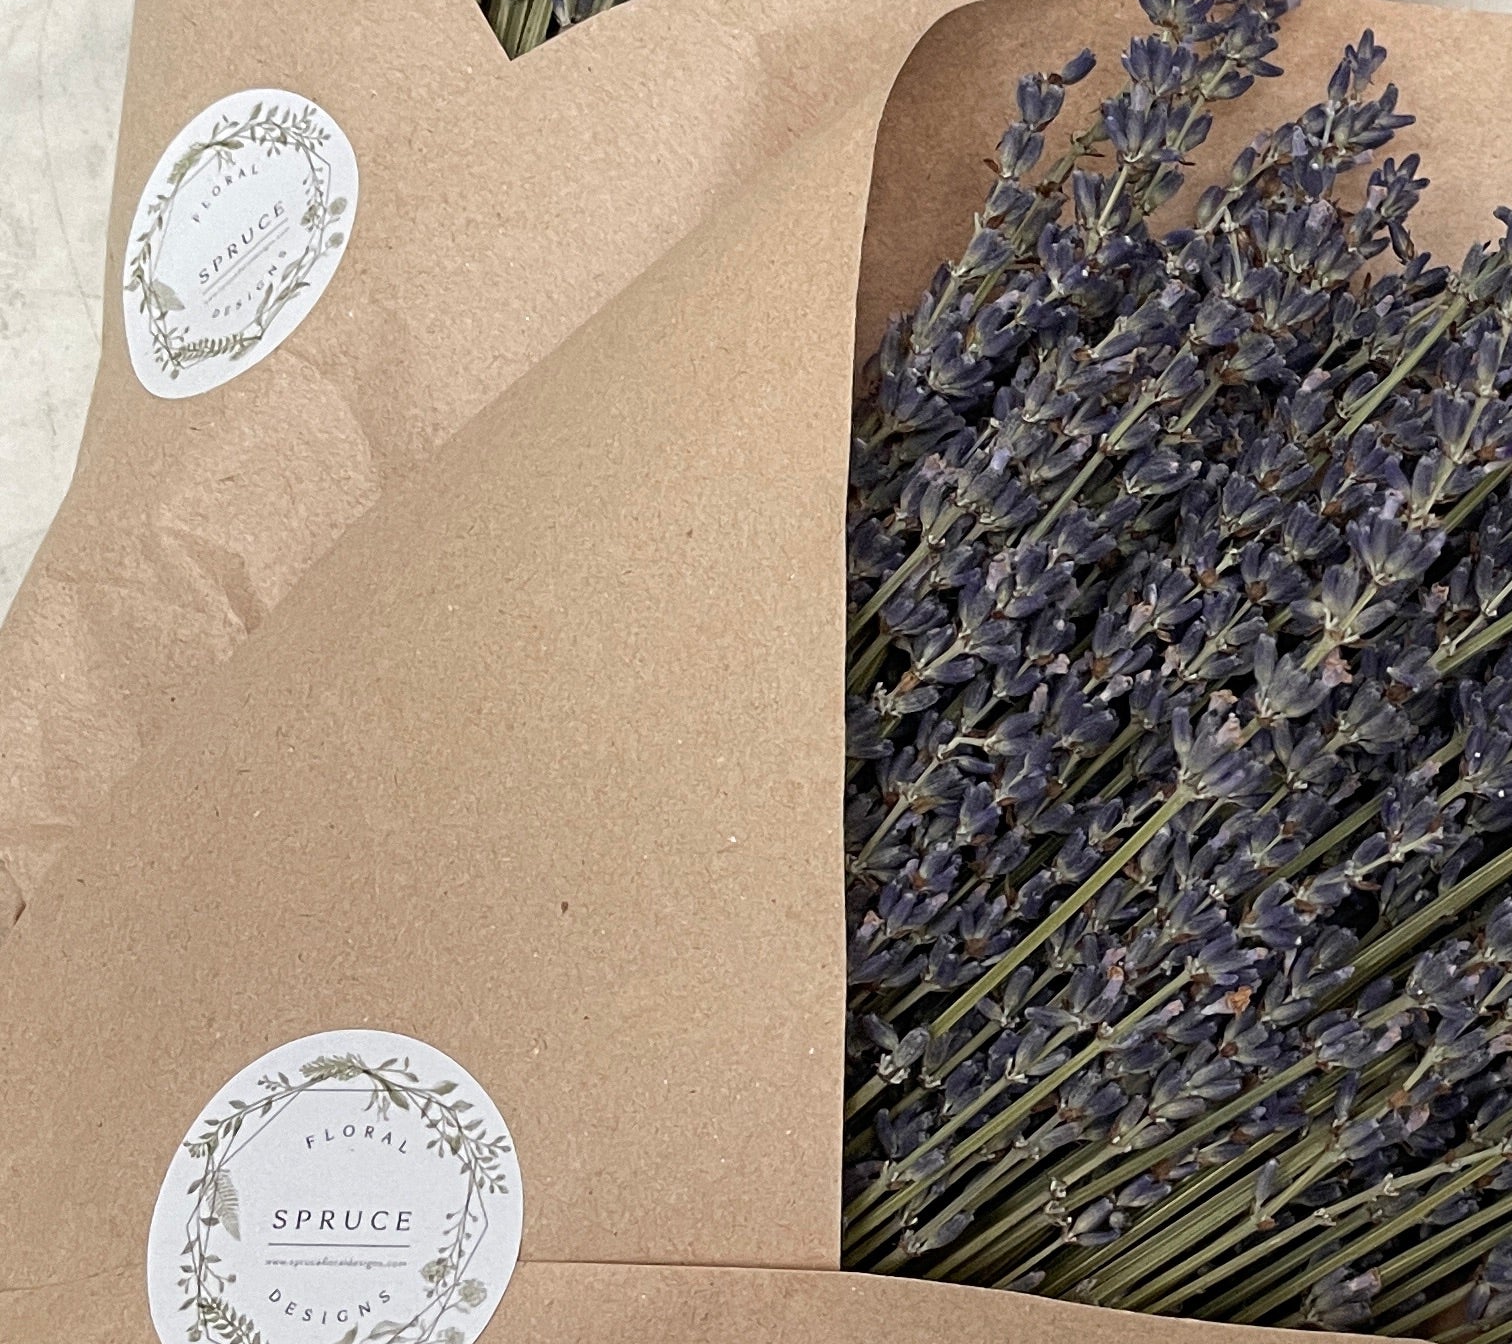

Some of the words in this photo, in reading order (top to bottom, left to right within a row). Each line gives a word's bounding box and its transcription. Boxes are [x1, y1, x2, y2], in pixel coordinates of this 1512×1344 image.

[192, 163, 259, 222] FLORAL
[199, 200, 284, 284] SPRUCE
[212, 251, 286, 318] DESIGNS
[305, 1124, 408, 1154] FLORAL
[272, 1209, 412, 1231] SPRUCE
[269, 1288, 391, 1323] DESIGNS
